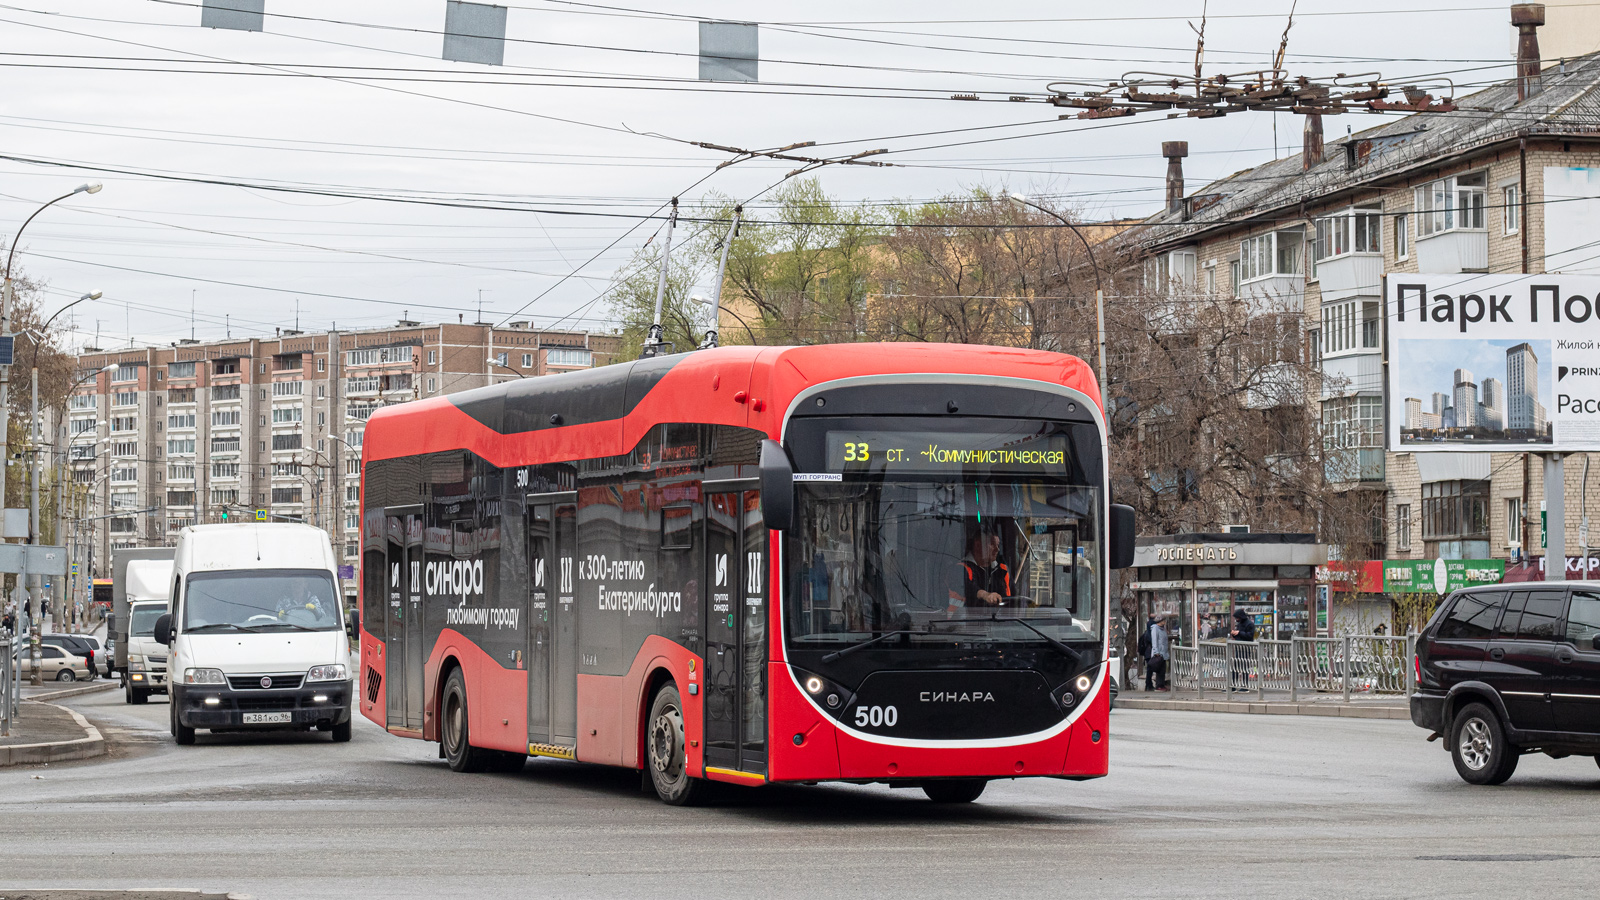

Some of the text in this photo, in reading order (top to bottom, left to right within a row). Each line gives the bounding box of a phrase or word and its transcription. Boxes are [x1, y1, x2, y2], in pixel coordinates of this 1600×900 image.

[1397, 283, 1600, 333] Парк По
[1556, 339, 1594, 350] Жилой
[843, 442, 1064, 464] 33 ст. ~Коммунистическая
[516, 469, 529, 487] 500
[1157, 547, 1237, 561] РОСПЕЧАТЬ
[578, 554, 645, 580] к 300-летию
[1538, 557, 1600, 572] ПКАР
[425, 559, 483, 605] синара
[598, 583, 681, 618] Екатеринбурга
[713, 593, 729, 603] группа
[446, 602, 520, 630] любимому городу
[713, 604, 729, 613] синара
[919, 691, 995, 702] СИНАРА
[854, 705, 898, 727] 500
